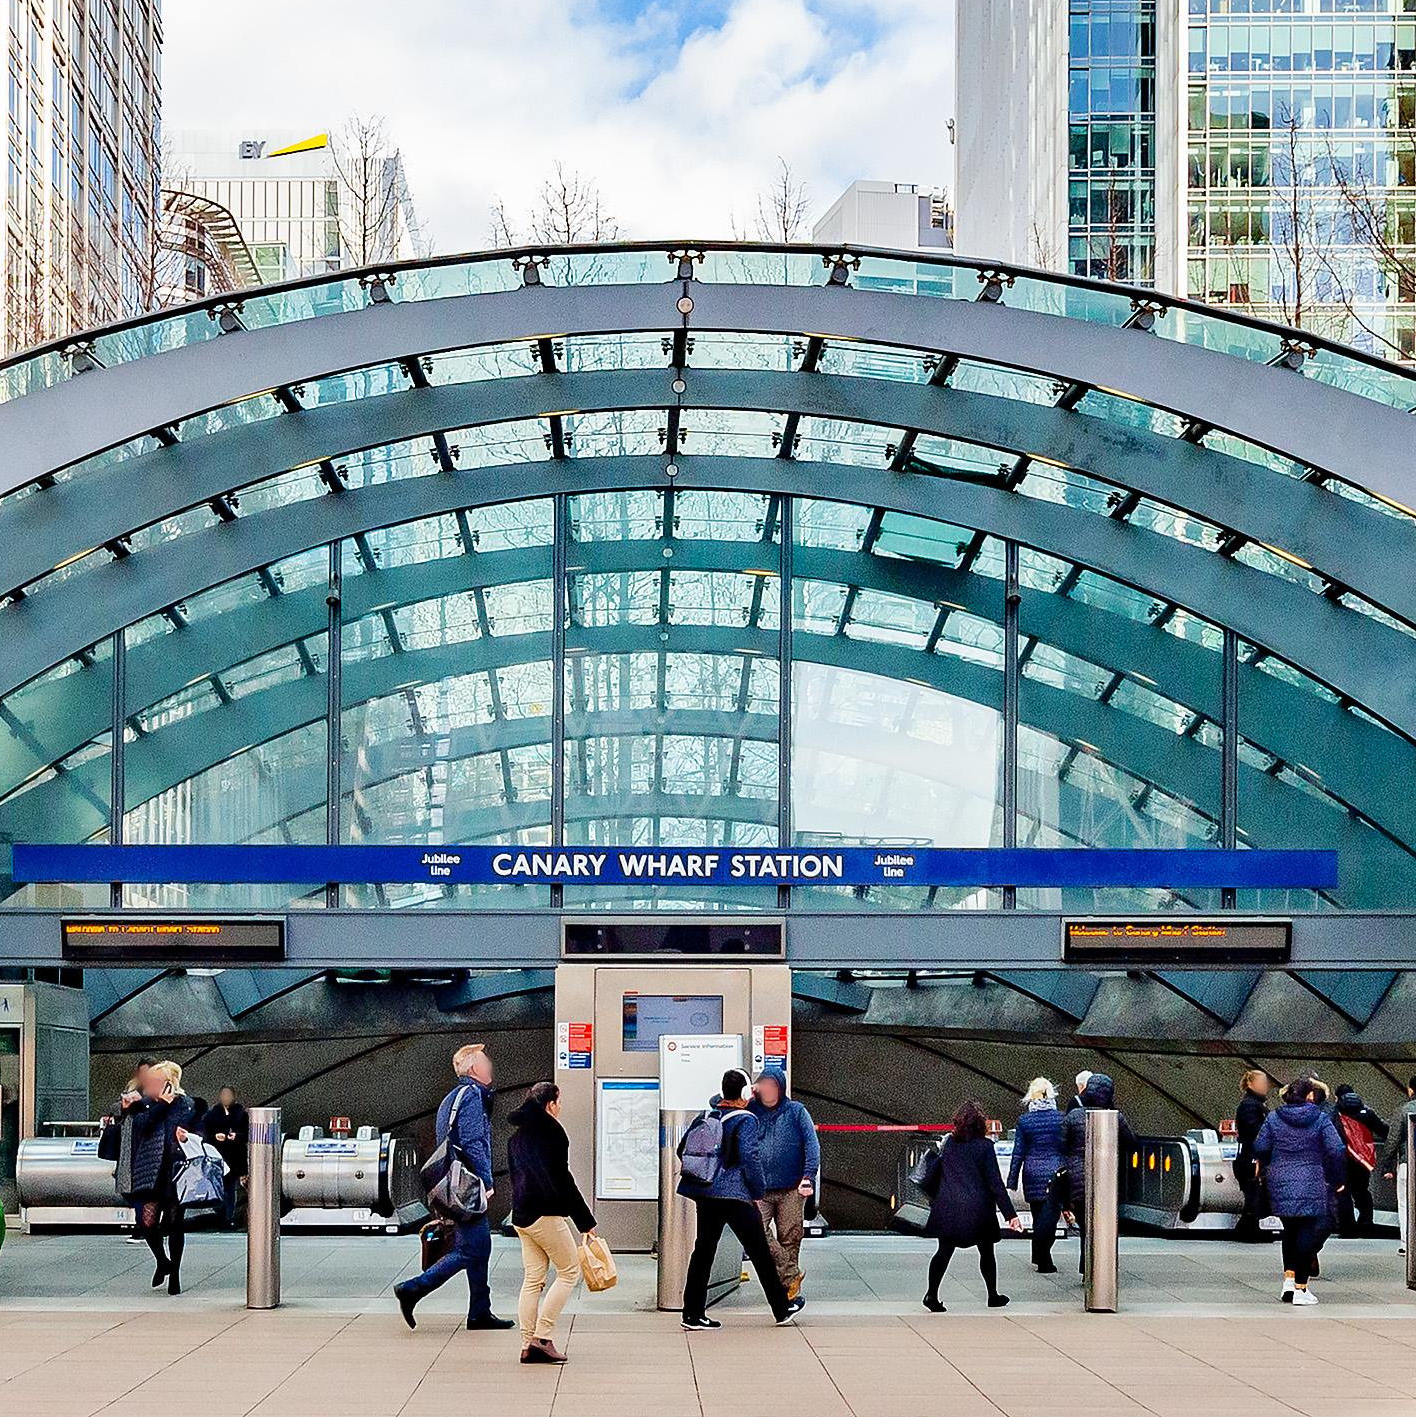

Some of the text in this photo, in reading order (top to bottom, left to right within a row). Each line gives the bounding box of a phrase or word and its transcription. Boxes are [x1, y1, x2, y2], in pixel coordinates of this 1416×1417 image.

[239, 141, 266, 159] EY
[422, 853, 460, 864] Jubilee
[874, 855, 914, 866] Jubilee
[430, 865, 451, 876] line
[492, 853, 843, 878] CANARY WHARF STATION
[883, 866, 904, 877] line
